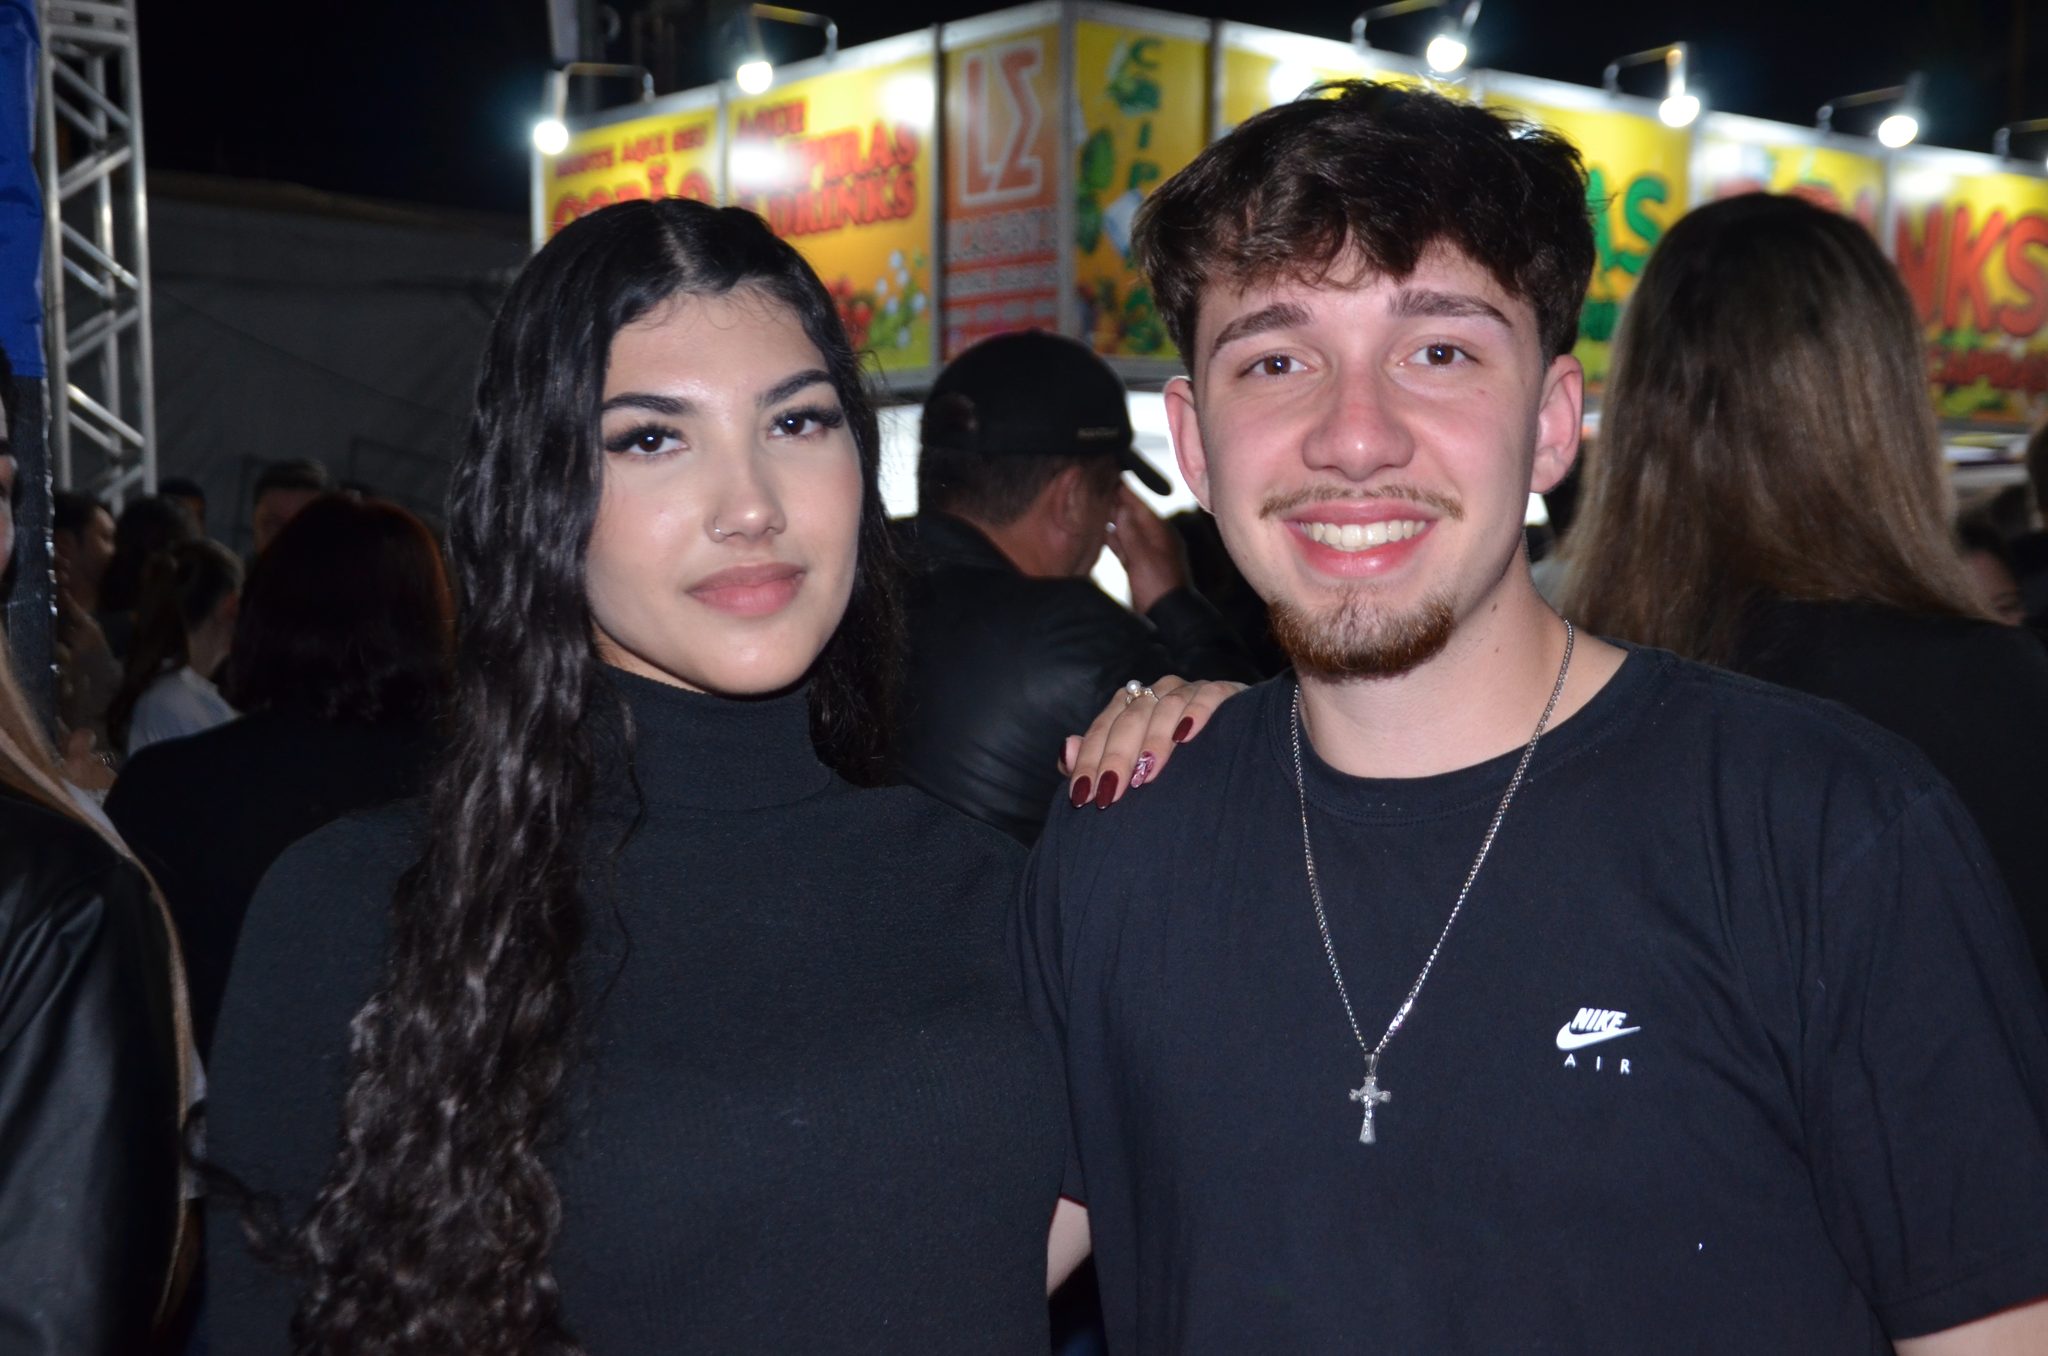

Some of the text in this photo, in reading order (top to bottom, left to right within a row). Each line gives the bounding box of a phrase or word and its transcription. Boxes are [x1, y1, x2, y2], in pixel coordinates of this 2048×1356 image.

[768, 169, 917, 238] DRINKS
[1571, 1007, 1627, 1033] NIKE
[1564, 1053, 1631, 1075] AIR
